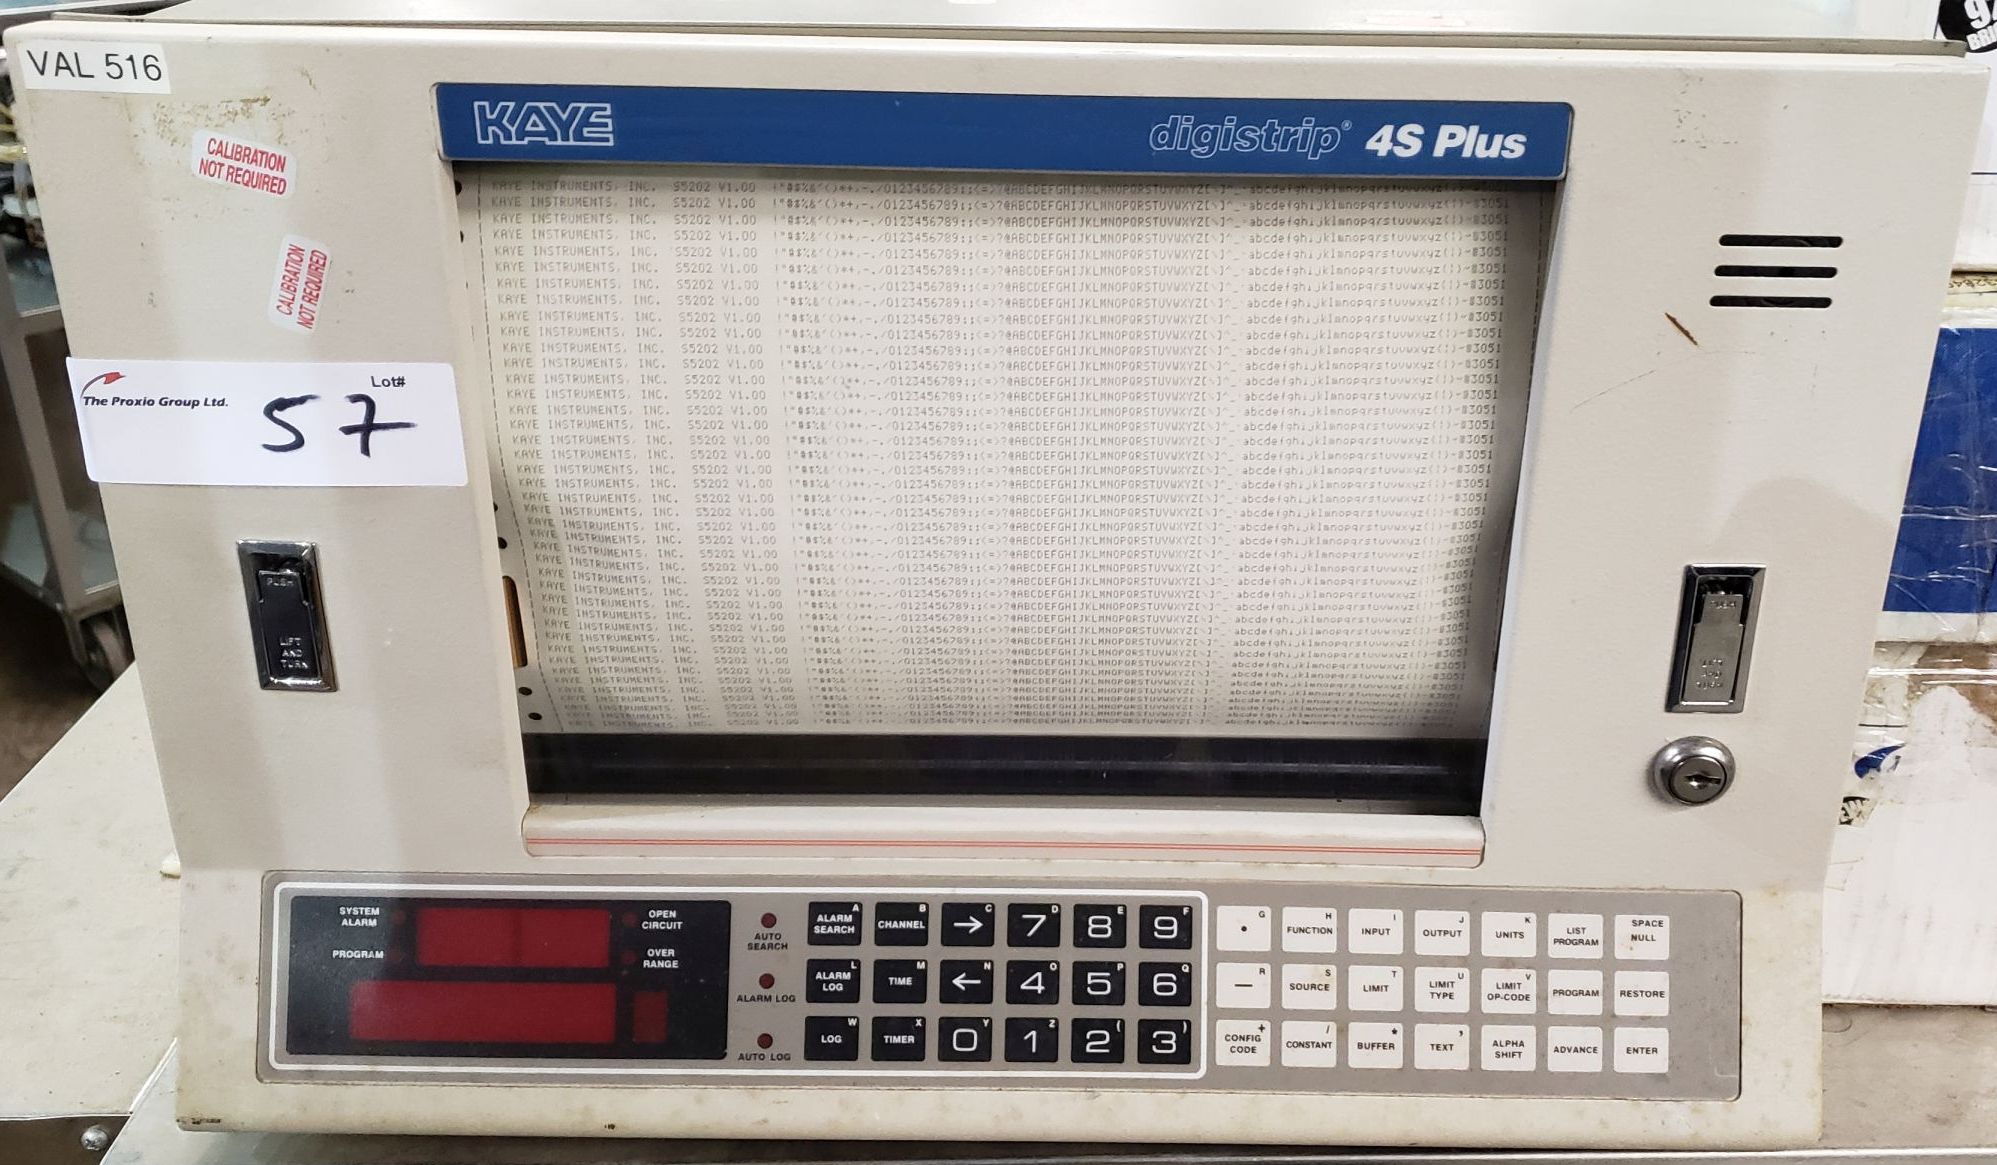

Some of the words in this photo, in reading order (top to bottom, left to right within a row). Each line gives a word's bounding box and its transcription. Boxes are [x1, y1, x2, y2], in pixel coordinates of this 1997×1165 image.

[27, 49, 95, 79] VAL
[105, 54, 162, 81] 516
[474, 101, 614, 146] KAYE
[1365, 124, 1426, 157] 4S
[1432, 125, 1528, 159] Plus
[207, 138, 286, 173] CALIBRATION
[199, 158, 225, 180] NOT
[226, 166, 287, 196] REQUIRED
[492, 196, 522, 207] KAYE
[492, 214, 522, 224] KAYE
[493, 230, 523, 240] KAYE
[276, 244, 305, 316] CALIBRATION
[302, 250, 327, 304] REQUIRED
[497, 279, 527, 288] KAYE
[297, 298, 315, 329] NOT
[371, 375, 405, 389] Lot#
[506, 389, 536, 399] KAYE
[84, 396, 107, 406] The
[112, 396, 154, 407] Proxio
[158, 397, 200, 410] Group
[204, 397, 228, 407] Ltd.
[524, 504, 551, 515] KAYE
[534, 541, 560, 552] KAYE
[339, 907, 380, 916] SYSTEM
[852, 904, 859, 912] A
[919, 904, 926, 912] B
[985, 904, 992, 913] C
[1052, 905, 1058, 913] D
[1184, 907, 1189, 915] F
[648, 910, 677, 919] OPEN
[817, 914, 852, 923] ALARM
[341, 918, 377, 927] ALARM
[642, 921, 683, 930] CIRCUIT
[878, 921, 925, 929] CHANNEL
[1021, 914, 1047, 937] 7
[1632, 920, 1663, 928] SPACE
[814, 926, 855, 934] SEARCH
[1088, 916, 1112, 938] 8
[1154, 916, 1177, 939] 9
[1287, 927, 1333, 935] FUNCTION
[1567, 927, 1586, 935] LIST
[1361, 928, 1391, 936] INPUT
[1423, 929, 1462, 937] OUTPUT
[1495, 931, 1524, 939] UNITS
[754, 933, 782, 941] AUTO
[1631, 934, 1656, 942] NULL
[1553, 938, 1599, 946] PROGRAM
[747, 943, 788, 951] SEARCH
[333, 950, 384, 959] PROGRAM
[647, 949, 675, 957] OVER
[643, 960, 678, 968] RANGE
[984, 962, 991, 970] N
[816, 972, 851, 980] ALARM
[889, 978, 912, 986] TIME
[1020, 972, 1045, 994] 4
[1087, 972, 1111, 995] 5
[1153, 972, 1177, 996] 6
[1496, 982, 1522, 990] LIMIT
[823, 983, 843, 991] LOG
[1290, 983, 1330, 991] SOURCE
[1363, 985, 1389, 993] LIMIT
[1431, 992, 1454, 1000] TYPE
[1487, 993, 1530, 1001] OP-CODE
[1553, 989, 1599, 997] PROGRAM
[1620, 990, 1665, 998] RESTORE
[737, 995, 772, 1003] ALARM
[775, 995, 796, 1003] LOG
[916, 1019, 922, 1027] X
[983, 1019, 989, 1027] Y
[1049, 1020, 1055, 1028] Z
[821, 1035, 842, 1043] LOG
[884, 1036, 915, 1044] TIMER
[1024, 1031, 1036, 1053] 1
[1086, 1030, 1110, 1053] 2
[1225, 1034, 1261, 1042] CONFIG
[1152, 1031, 1177, 1054] 3
[1286, 1041, 1332, 1049] CONSTANT
[1358, 1042, 1395, 1050] BUFFER
[1493, 1040, 1525, 1048] ALPHA
[1230, 1046, 1257, 1054] CODE
[1553, 1046, 1598, 1054] ADVANCE
[1626, 1047, 1658, 1055] ENTER
[738, 1053, 765, 1061] AUTO
[770, 1053, 791, 1061] LOG
[1495, 1051, 1522, 1059] SHIFT
